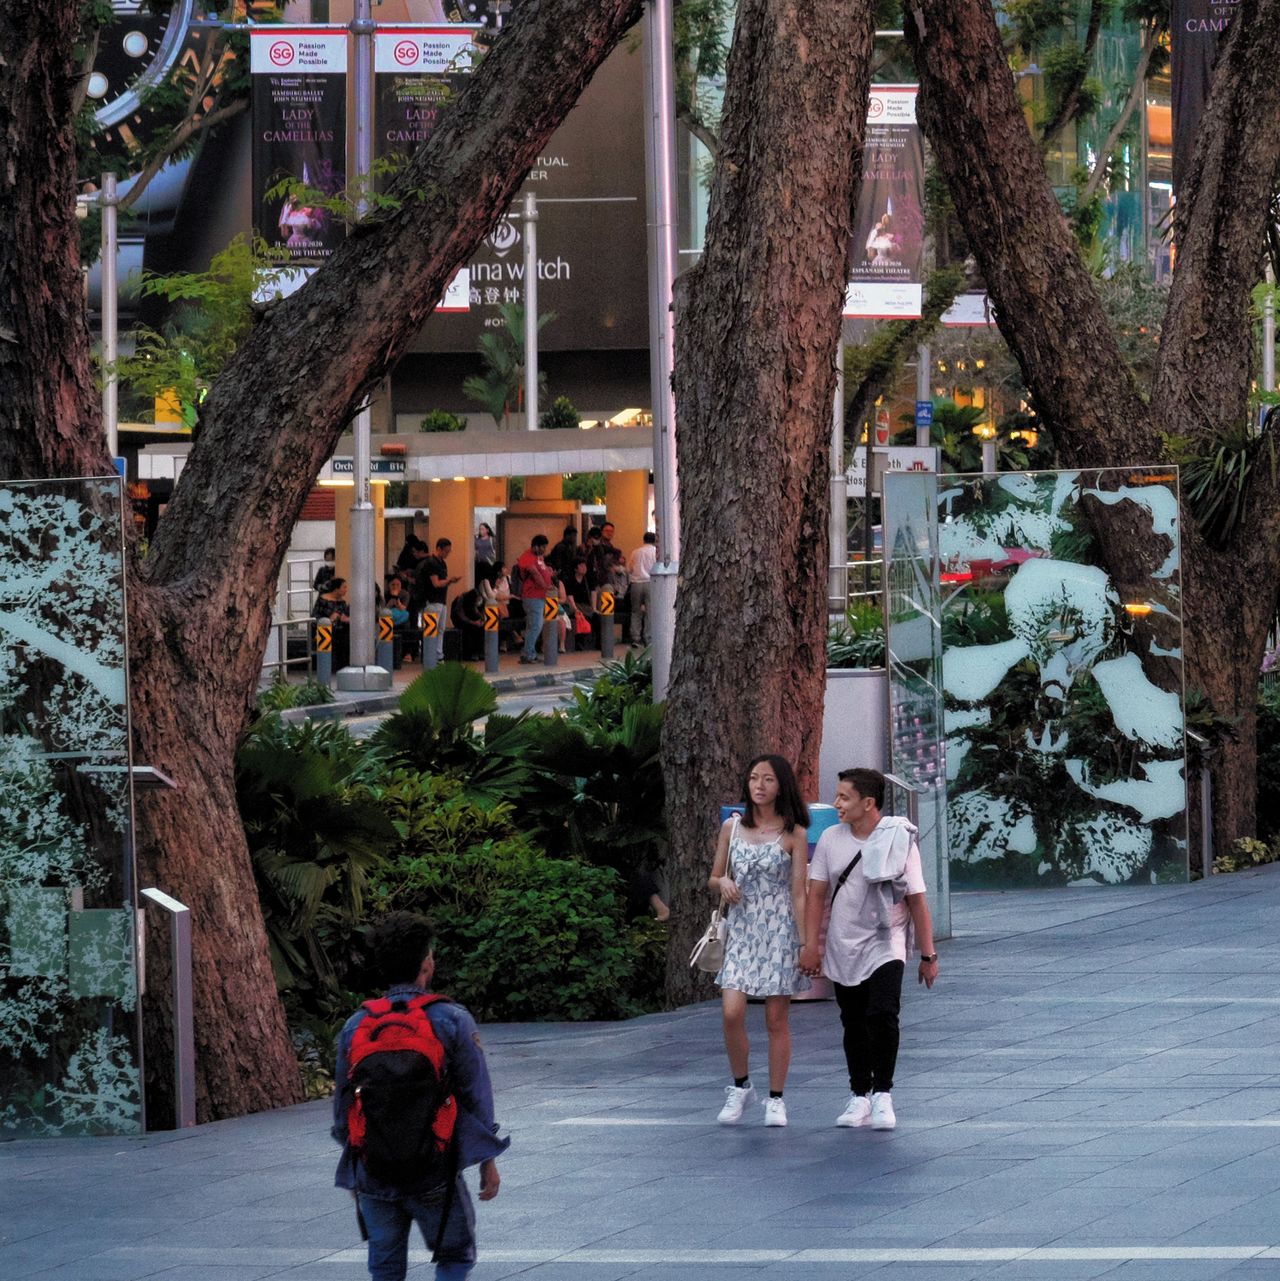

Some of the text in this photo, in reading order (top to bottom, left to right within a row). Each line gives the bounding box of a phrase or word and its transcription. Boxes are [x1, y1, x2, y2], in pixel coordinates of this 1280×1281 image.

[272, 48, 291, 59] SG
[397, 48, 416, 58] SG
[282, 110, 314, 120] LADY
[406, 110, 437, 120] LADY
[263, 130, 334, 142] CAMELLIAS
[872, 154, 897, 162] LADY
[864, 171, 914, 179] AMELLIAS
[506, 256, 570, 280] wtch
[470, 286, 526, 305] 高登钟
[334, 462, 353, 470] Orch
[390, 462, 404, 471] B14
